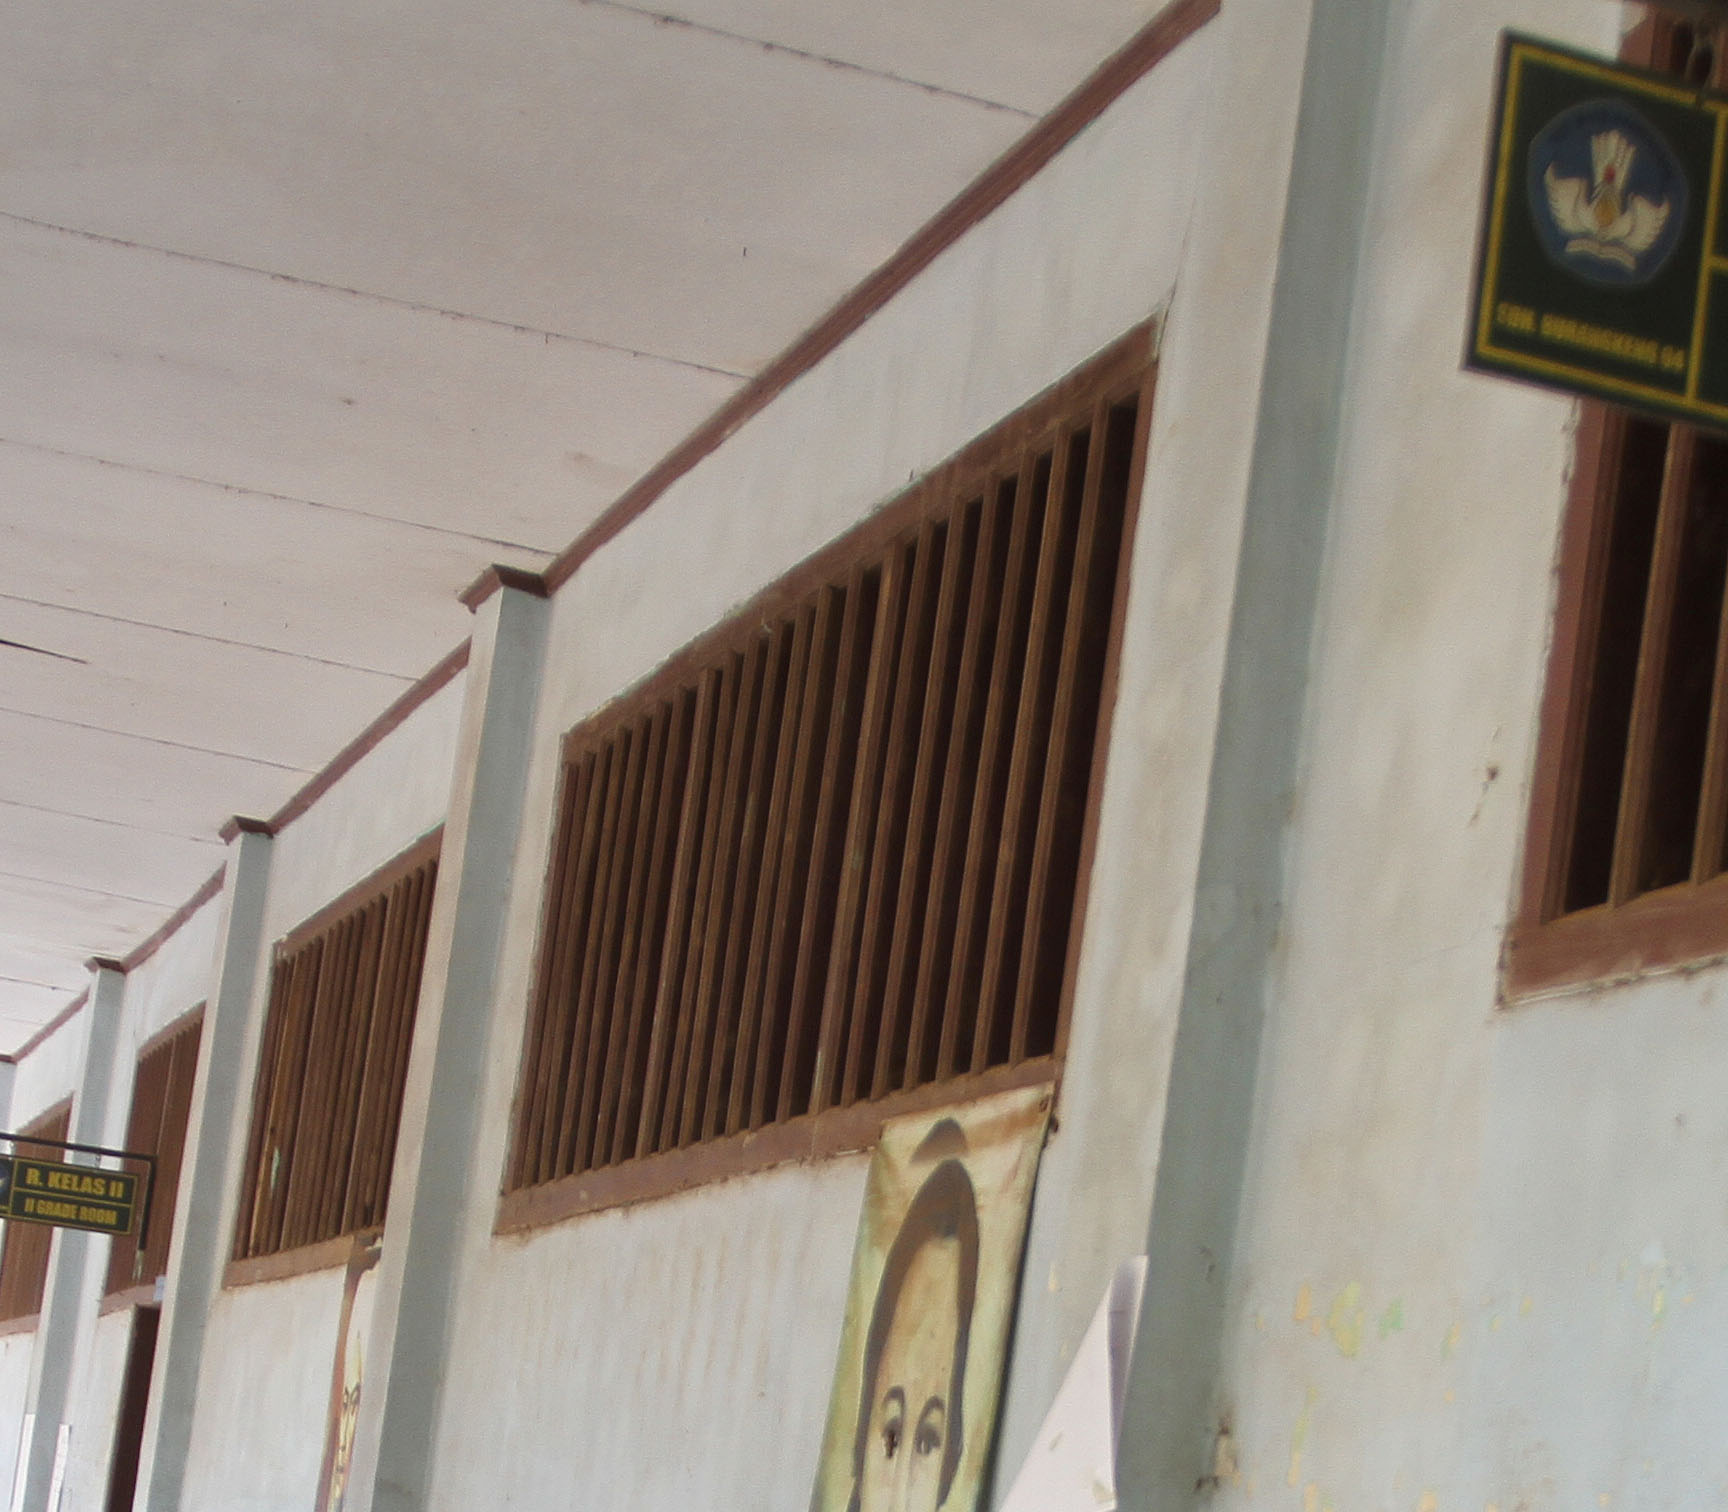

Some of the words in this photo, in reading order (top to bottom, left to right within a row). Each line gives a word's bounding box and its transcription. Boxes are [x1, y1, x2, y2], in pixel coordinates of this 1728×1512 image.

[25, 1167, 43, 1187] R.
[47, 1171, 105, 1196] KELAS
[109, 1180, 125, 1199] II
[24, 1197, 35, 1213] II
[37, 1200, 78, 1220] GRADE
[79, 1206, 118, 1225] ROOM
